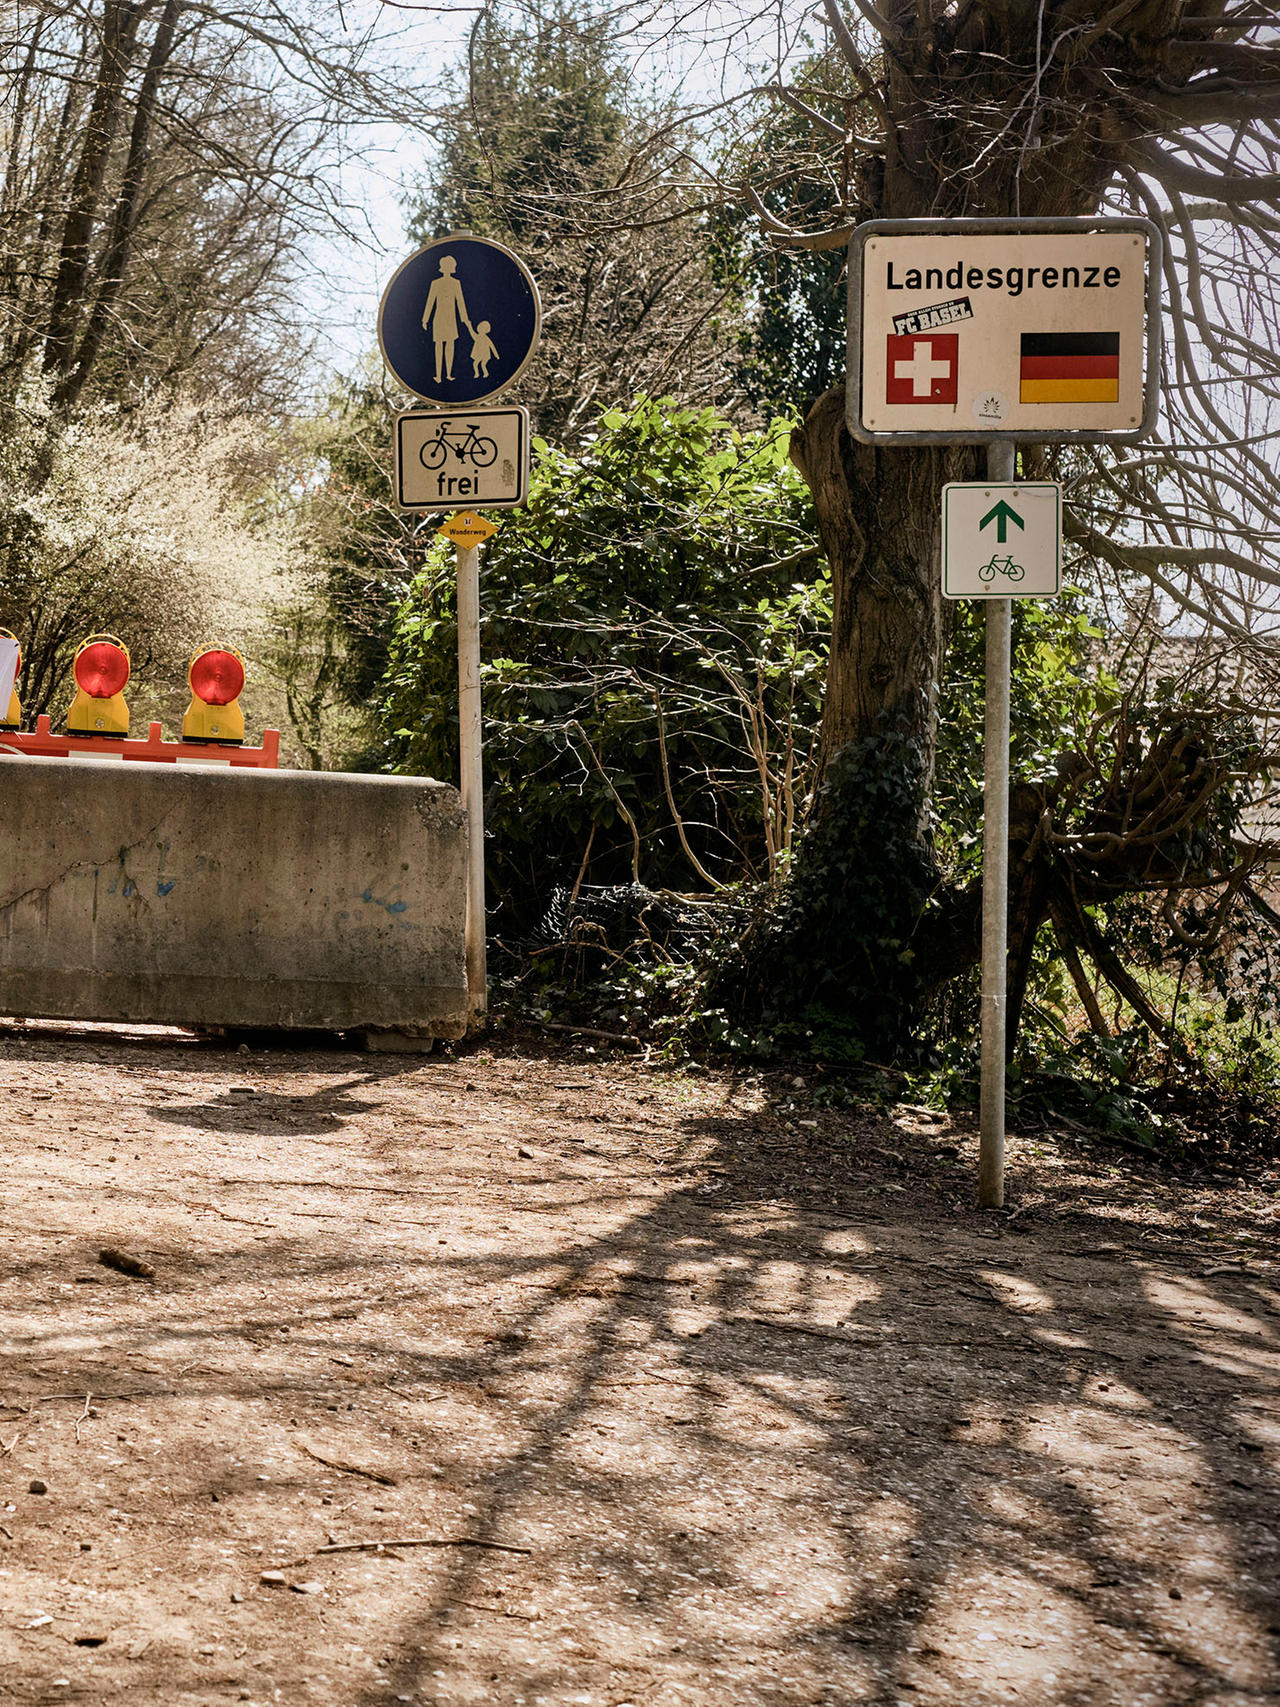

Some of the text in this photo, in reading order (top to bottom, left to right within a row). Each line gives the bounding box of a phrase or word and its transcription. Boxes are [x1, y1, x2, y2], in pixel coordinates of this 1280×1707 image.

[886, 261, 1121, 297] Landesgrenze
[895, 316, 918, 336] FC
[918, 303, 971, 330] BASEL
[437, 470, 479, 496] frei
[449, 528, 486, 536] Wanderweg
